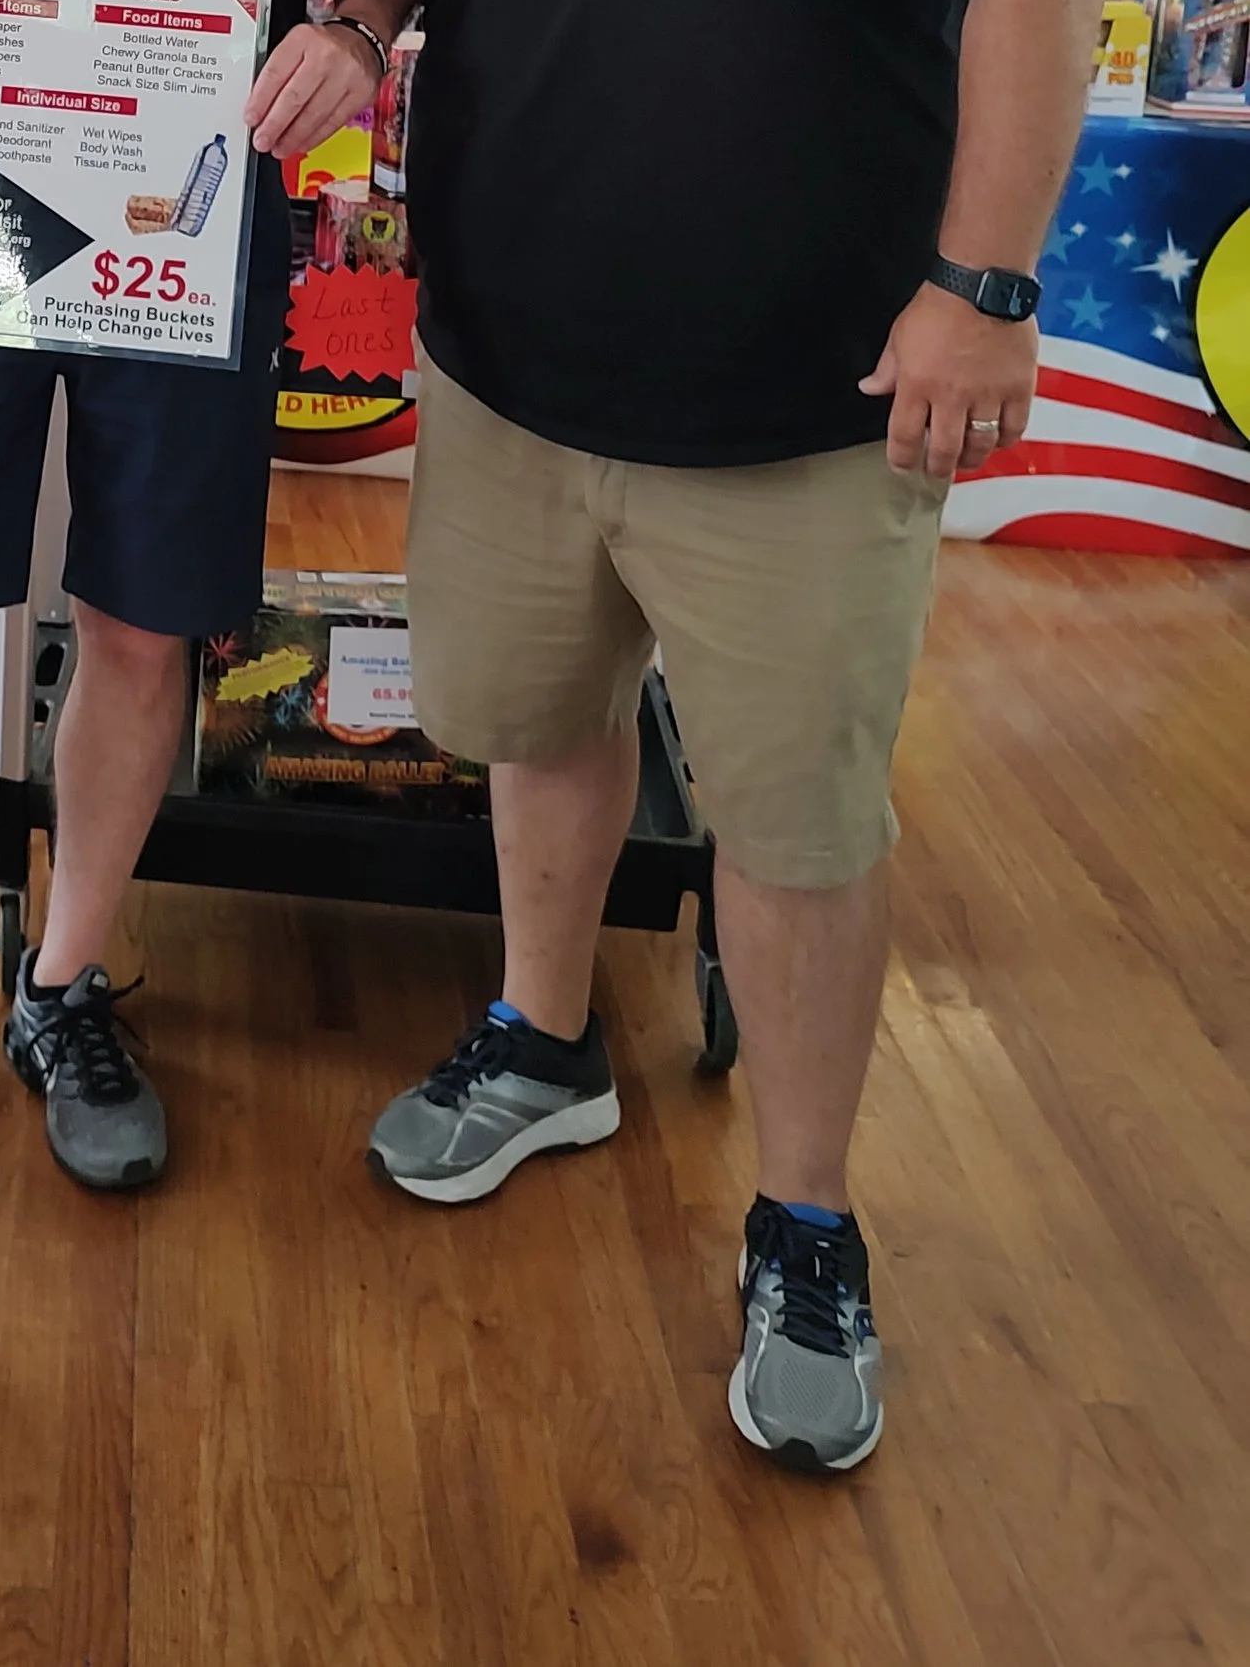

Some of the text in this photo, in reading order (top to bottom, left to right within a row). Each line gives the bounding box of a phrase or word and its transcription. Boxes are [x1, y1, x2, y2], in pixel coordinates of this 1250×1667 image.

[122, 10, 203, 29] Food Items
[123, 32, 199, 49] Bottled Water
[102, 45, 218, 65] Chewy Granola Bars
[93, 60, 224, 81] Peanut Butter Crackers
[97, 75, 217, 96] Snack Size Slim Jims
[16, 90, 121, 112] Individual Size
[16, 120, 66, 135] Sanitizer
[82, 126, 143, 143] Wet Wipes
[80, 142, 143, 158] Body Wash
[74, 155, 147, 173] Tissue Packs
[44, 296, 216, 328] Purchasing Buckets
[311, 286, 399, 321] Last
[16, 310, 215, 344] Can Help Change Lives
[325, 330, 396, 358] ones
